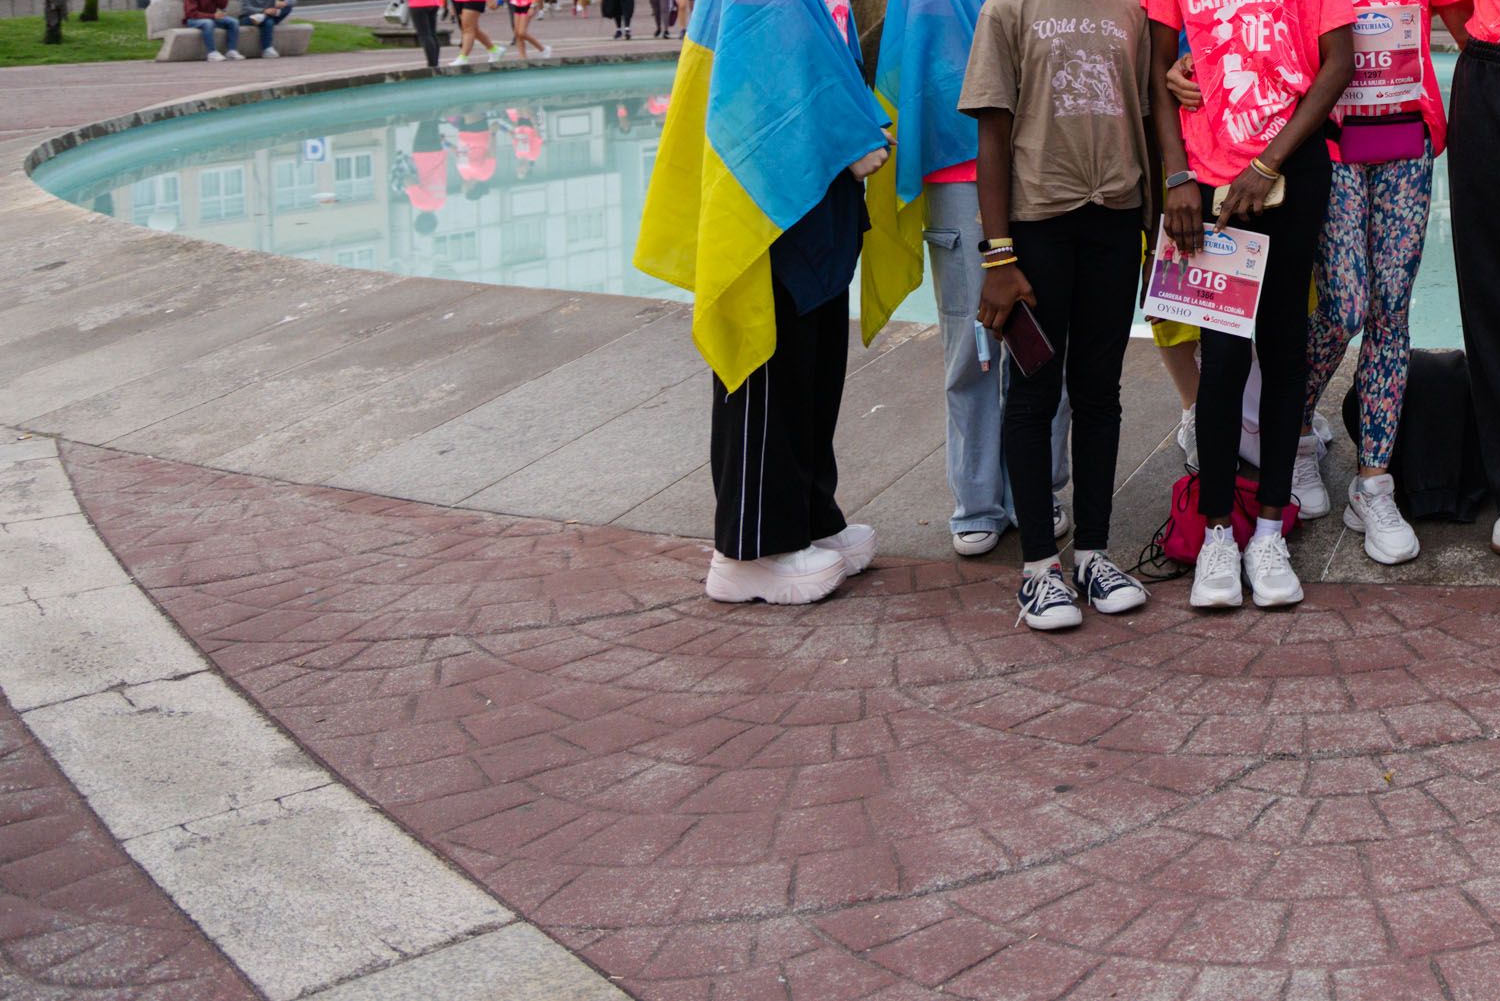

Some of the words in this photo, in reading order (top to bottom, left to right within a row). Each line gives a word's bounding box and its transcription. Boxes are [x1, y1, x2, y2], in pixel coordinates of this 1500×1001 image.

[1033, 18, 1077, 39] Wild
[1080, 18, 1096, 34] &
[1101, 20, 1128, 40] Free
[1241, 13, 1271, 52] DE
[1355, 51, 1392, 69] 016
[1364, 71, 1382, 80] 1297
[1341, 91, 1364, 100] SHO
[1204, 240, 1234, 251] TURIANA
[1188, 268, 1228, 291] 016
[1158, 291, 1182, 301] CARRERA
[1183, 296, 1191, 304] DE
[1191, 298, 1199, 306] LA
[1199, 300, 1216, 309] MUJER
[1157, 303, 1192, 318] OYSHO
[1211, 316, 1241, 329] Santander
